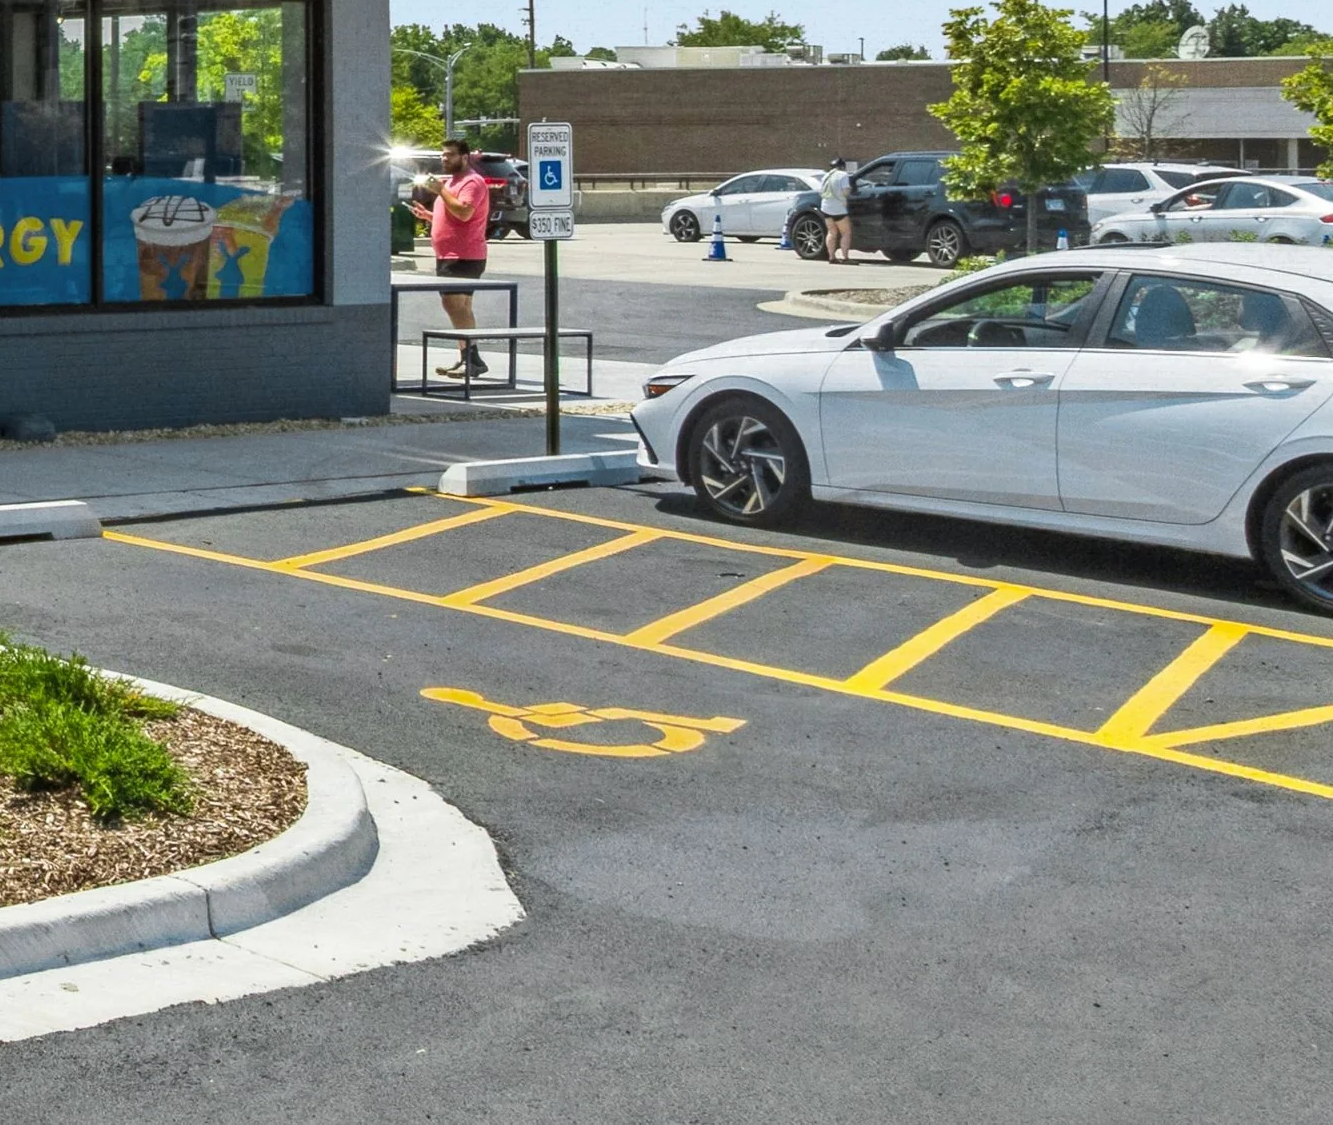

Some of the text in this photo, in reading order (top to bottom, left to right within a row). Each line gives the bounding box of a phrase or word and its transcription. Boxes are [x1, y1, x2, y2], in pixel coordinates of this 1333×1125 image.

[228, 77, 255, 87] YIELD
[532, 131, 569, 143] RESERVED
[534, 146, 567, 157] PARKING
[532, 217, 571, 233] $350 FINE
